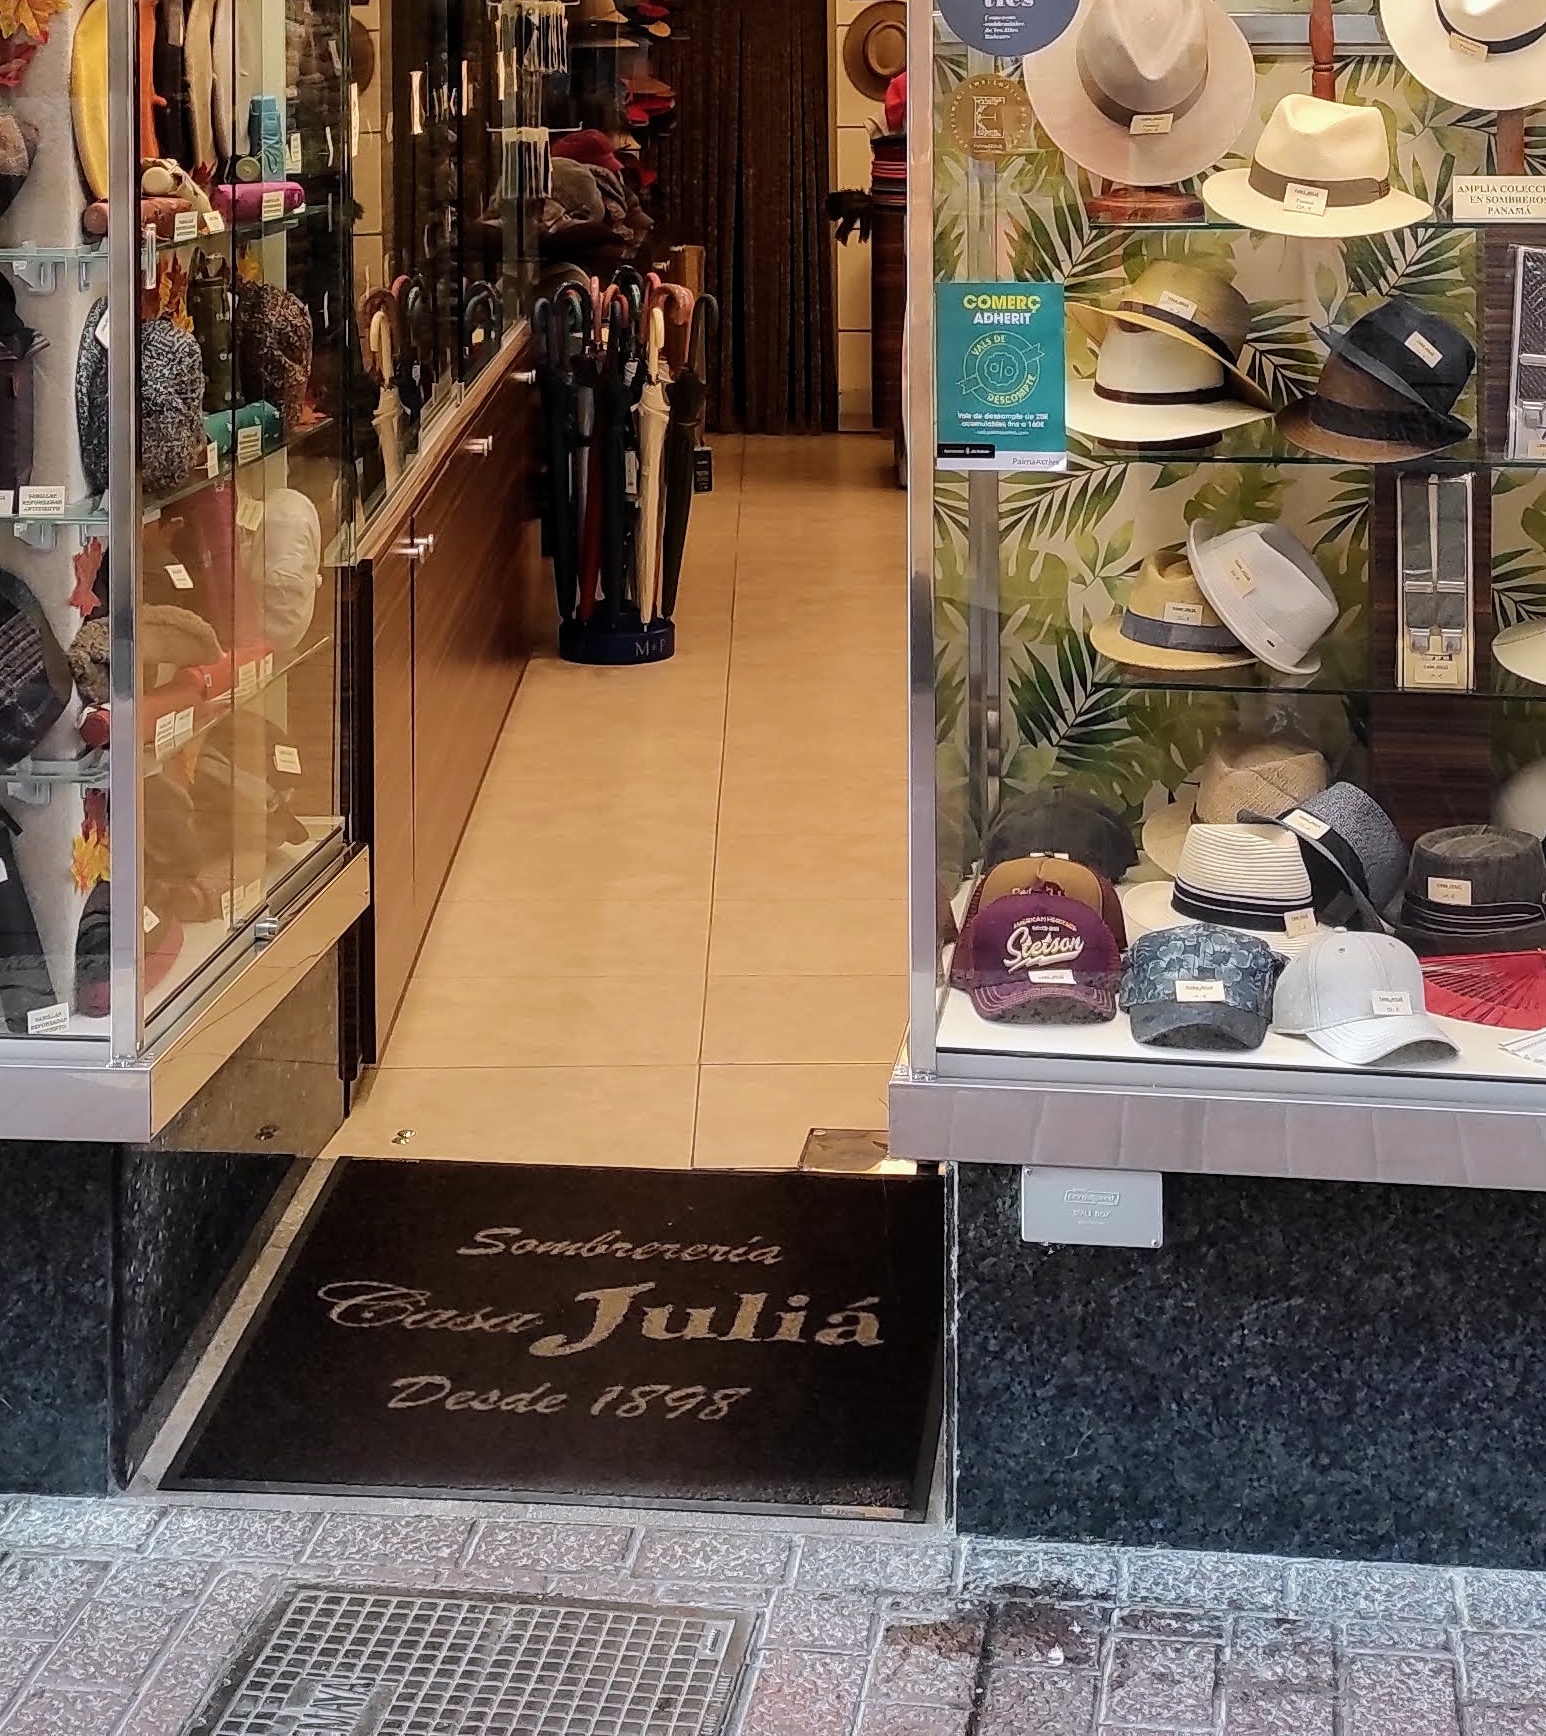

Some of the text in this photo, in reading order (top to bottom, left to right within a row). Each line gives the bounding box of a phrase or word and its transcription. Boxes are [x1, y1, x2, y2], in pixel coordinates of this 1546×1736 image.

[1470, 196, 1484, 204] EN
[1487, 205, 1532, 215] PANAMÁ
[963, 295, 1041, 313] COMERÇ
[973, 312, 1032, 325] ADHERIT
[1003, 926, 1085, 968] Stetson
[456, 1226, 783, 1264] Sombrerería
[317, 1281, 885, 1359] Casa Juliá
[387, 1374, 753, 1421] Desde 1898
